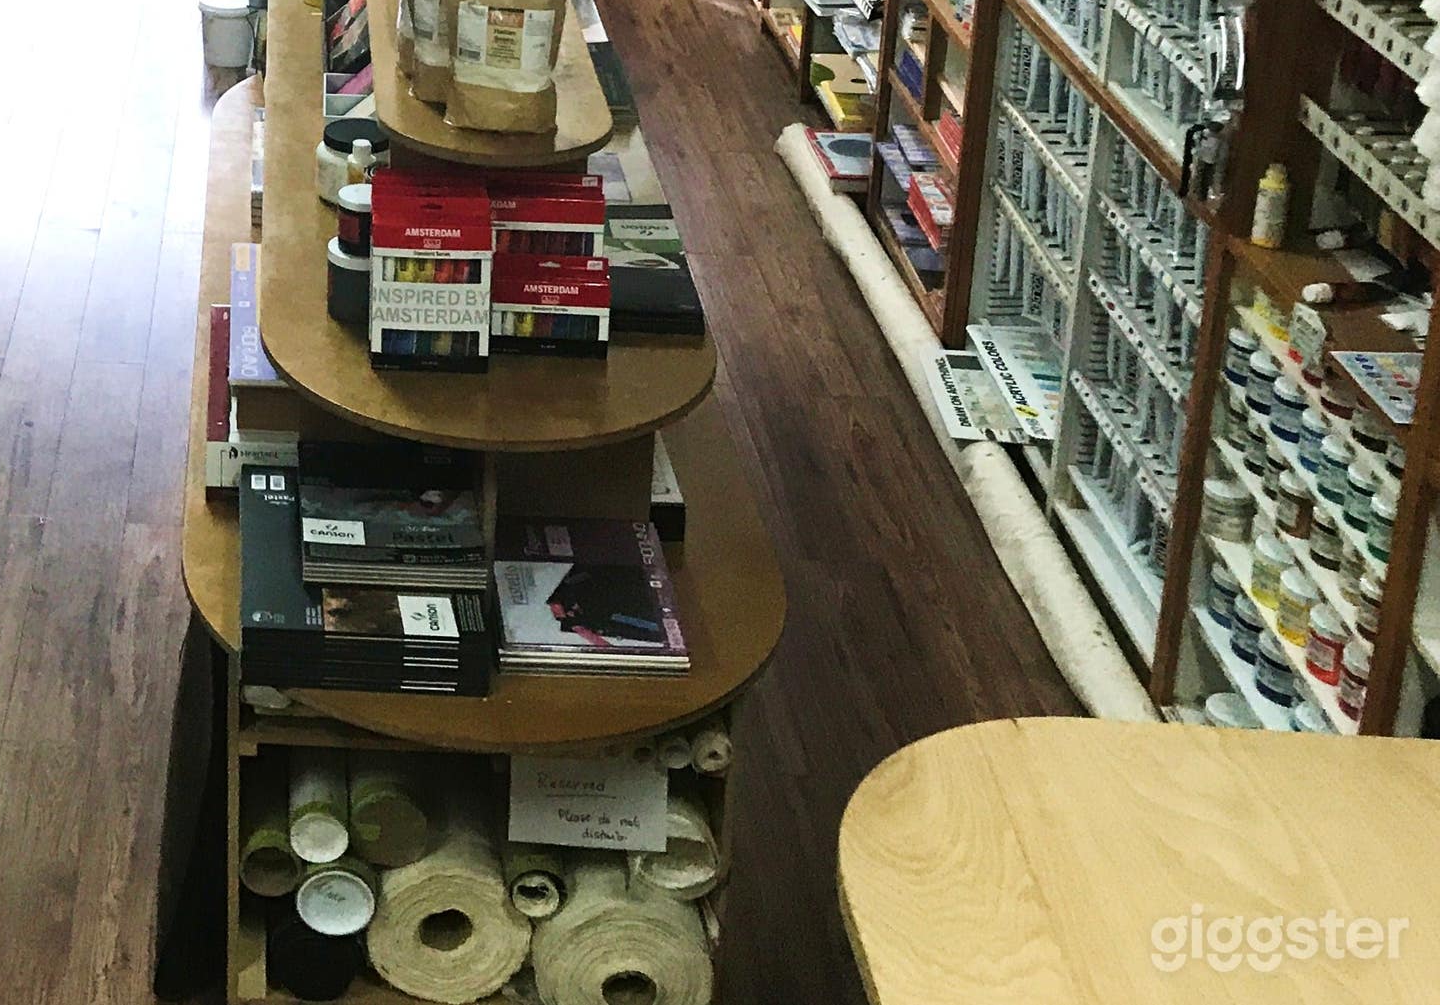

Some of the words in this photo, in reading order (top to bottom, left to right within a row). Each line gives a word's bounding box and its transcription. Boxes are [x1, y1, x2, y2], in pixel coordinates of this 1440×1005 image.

[404, 228, 461, 238] AMSTERDAM
[372, 287, 461, 305] INSPIRED
[465, 290, 489, 306] BY
[523, 284, 579, 295] AMSTERDAM
[372, 307, 490, 326] AMSTERDAM
[981, 340, 1008, 372] COLORS
[1000, 372, 1030, 408] ACRYLIC
[949, 394, 962, 407] ON
[955, 406, 972, 428] DRAW
[537, 772, 606, 792] Reserved
[558, 808, 591, 823] Please
[598, 811, 610, 825] do
